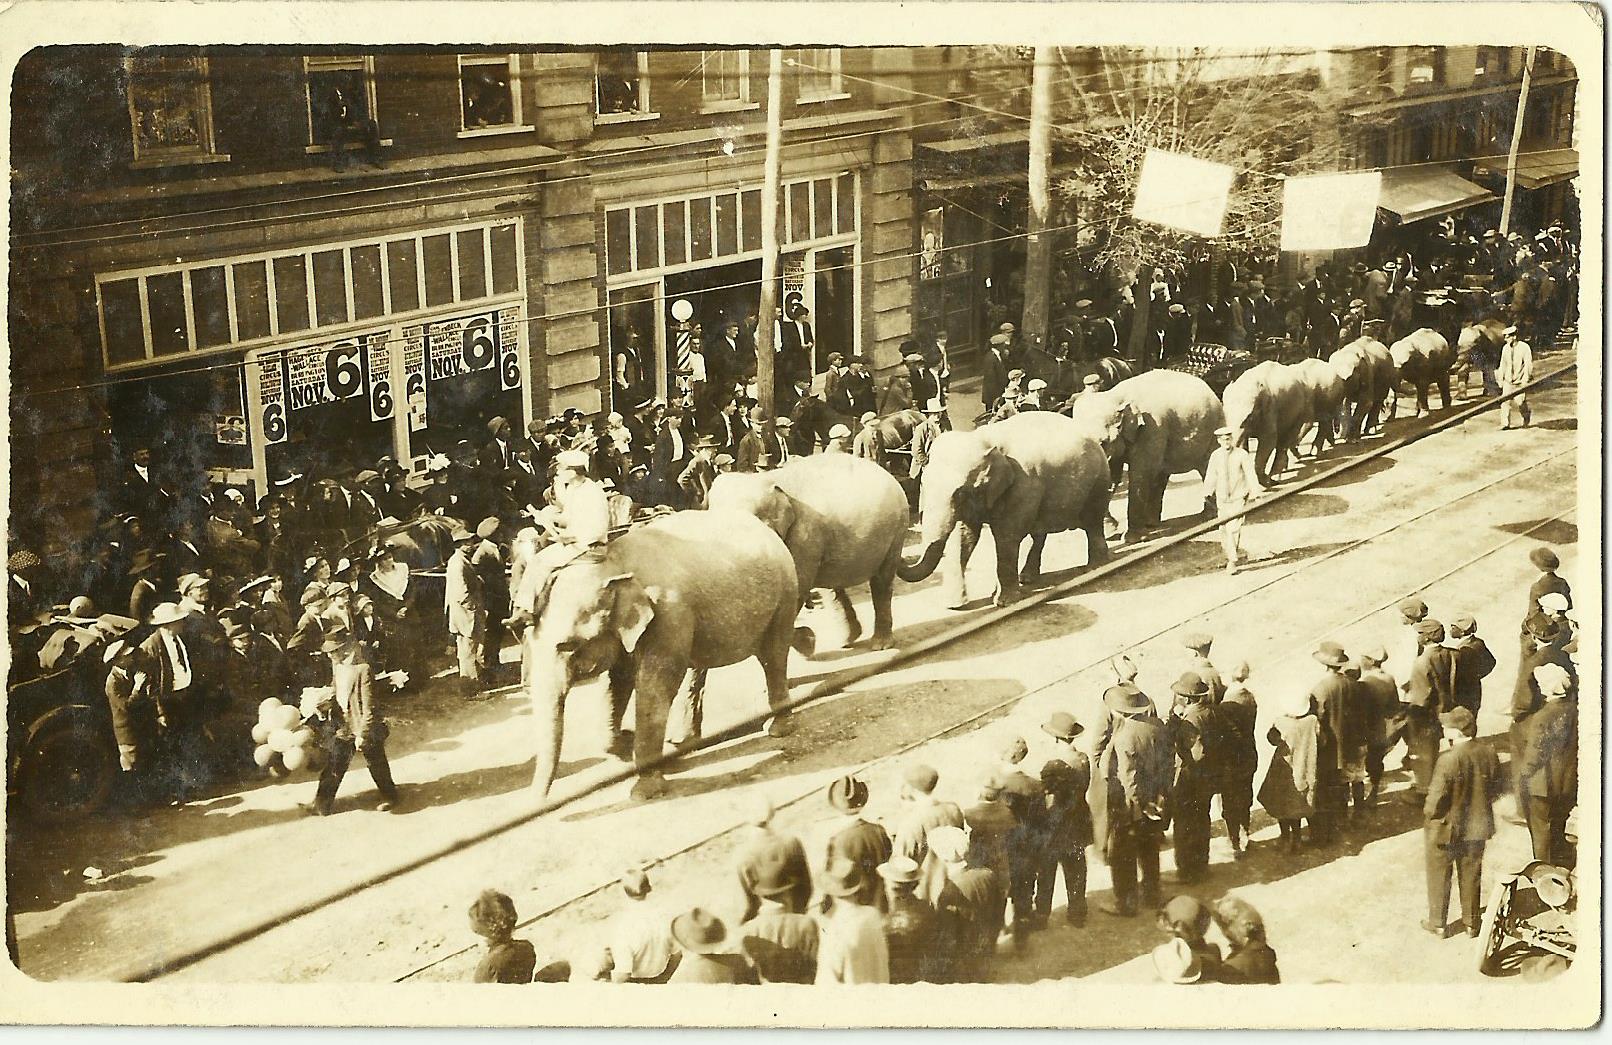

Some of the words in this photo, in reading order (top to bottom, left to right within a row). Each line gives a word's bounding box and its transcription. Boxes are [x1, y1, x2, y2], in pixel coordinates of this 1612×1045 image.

[785, 291, 804, 321] 6
[431, 353, 463, 379] NOV.
[463, 317, 494, 370] 6
[291, 381, 328, 409] NOV.
[326, 342, 362, 400] 6
[503, 352, 521, 387] 6
[372, 381, 393, 418] 6
[262, 403, 286, 442] 6
